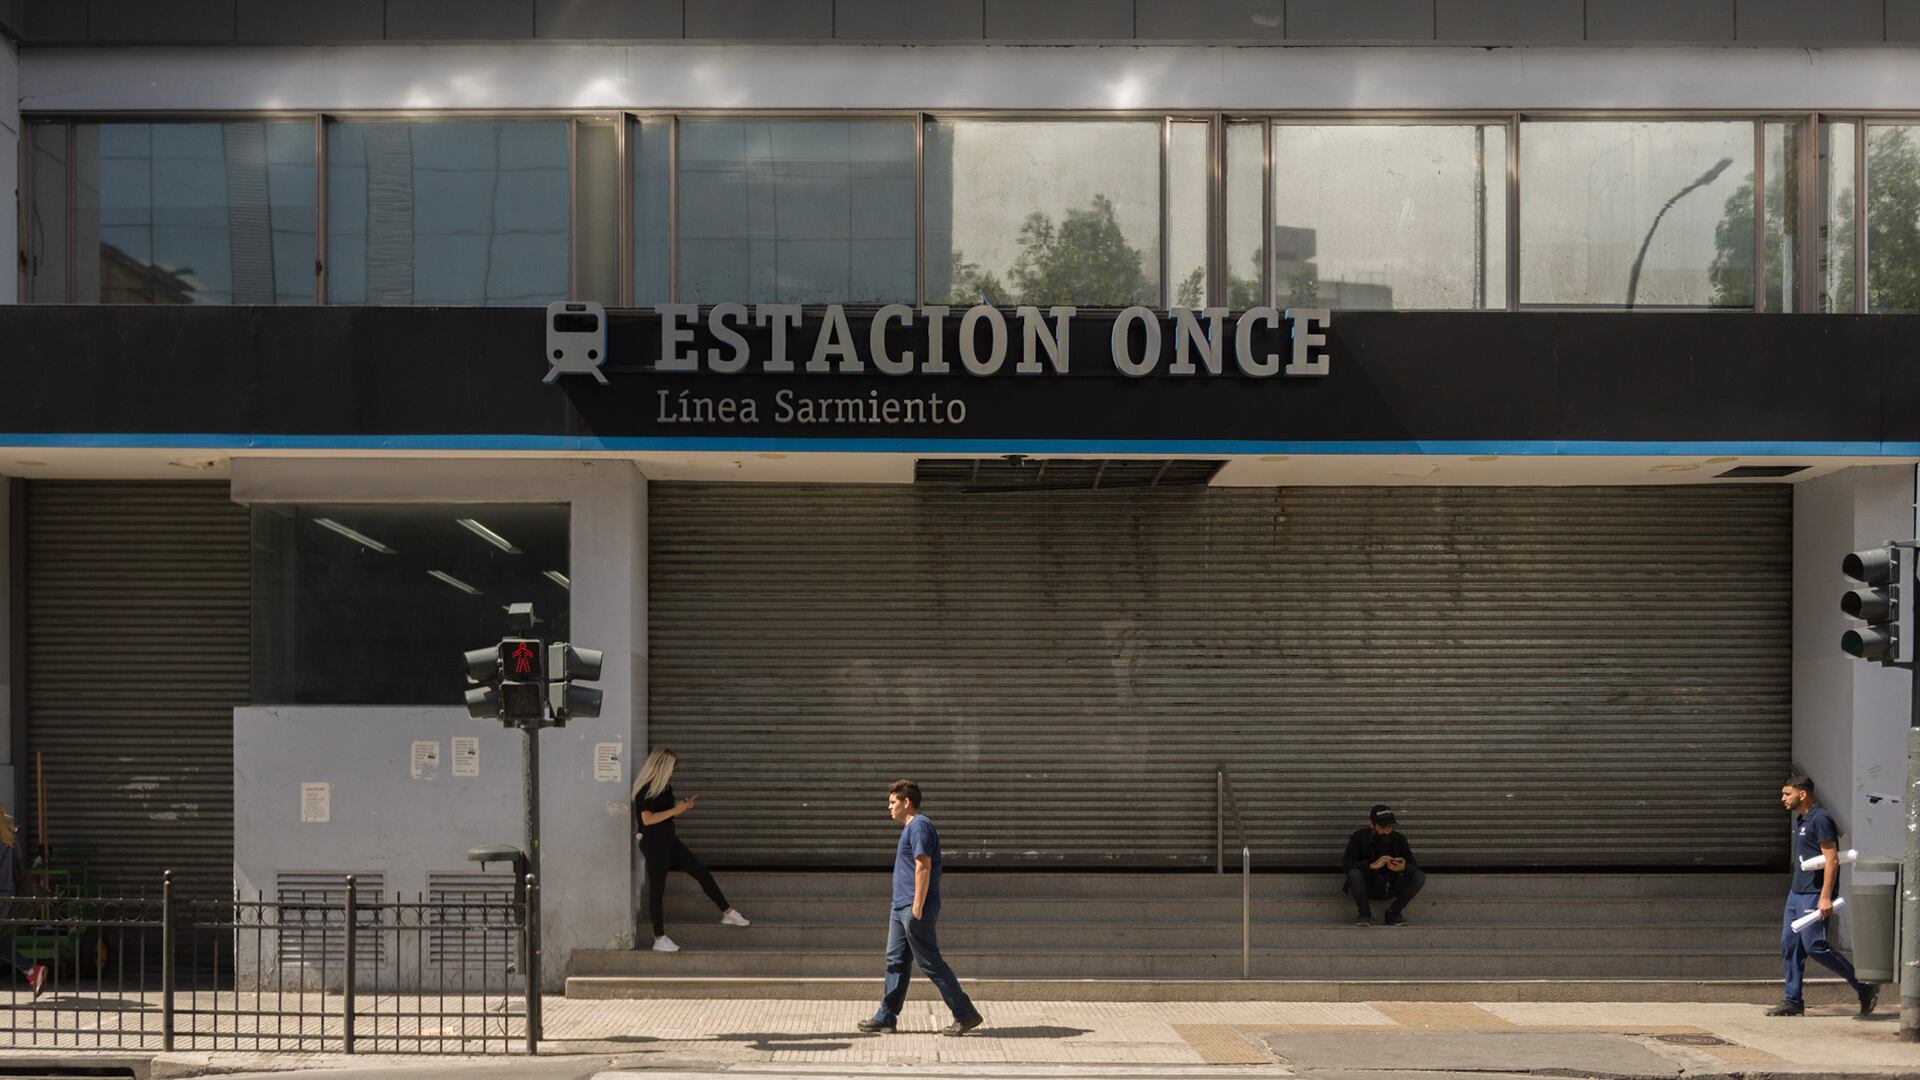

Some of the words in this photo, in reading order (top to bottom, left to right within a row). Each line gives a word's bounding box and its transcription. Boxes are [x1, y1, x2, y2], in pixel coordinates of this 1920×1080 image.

[1111, 306, 1331, 377] ONCE
[656, 390, 760, 424] Línea
[774, 389, 967, 424] Sarmiento
